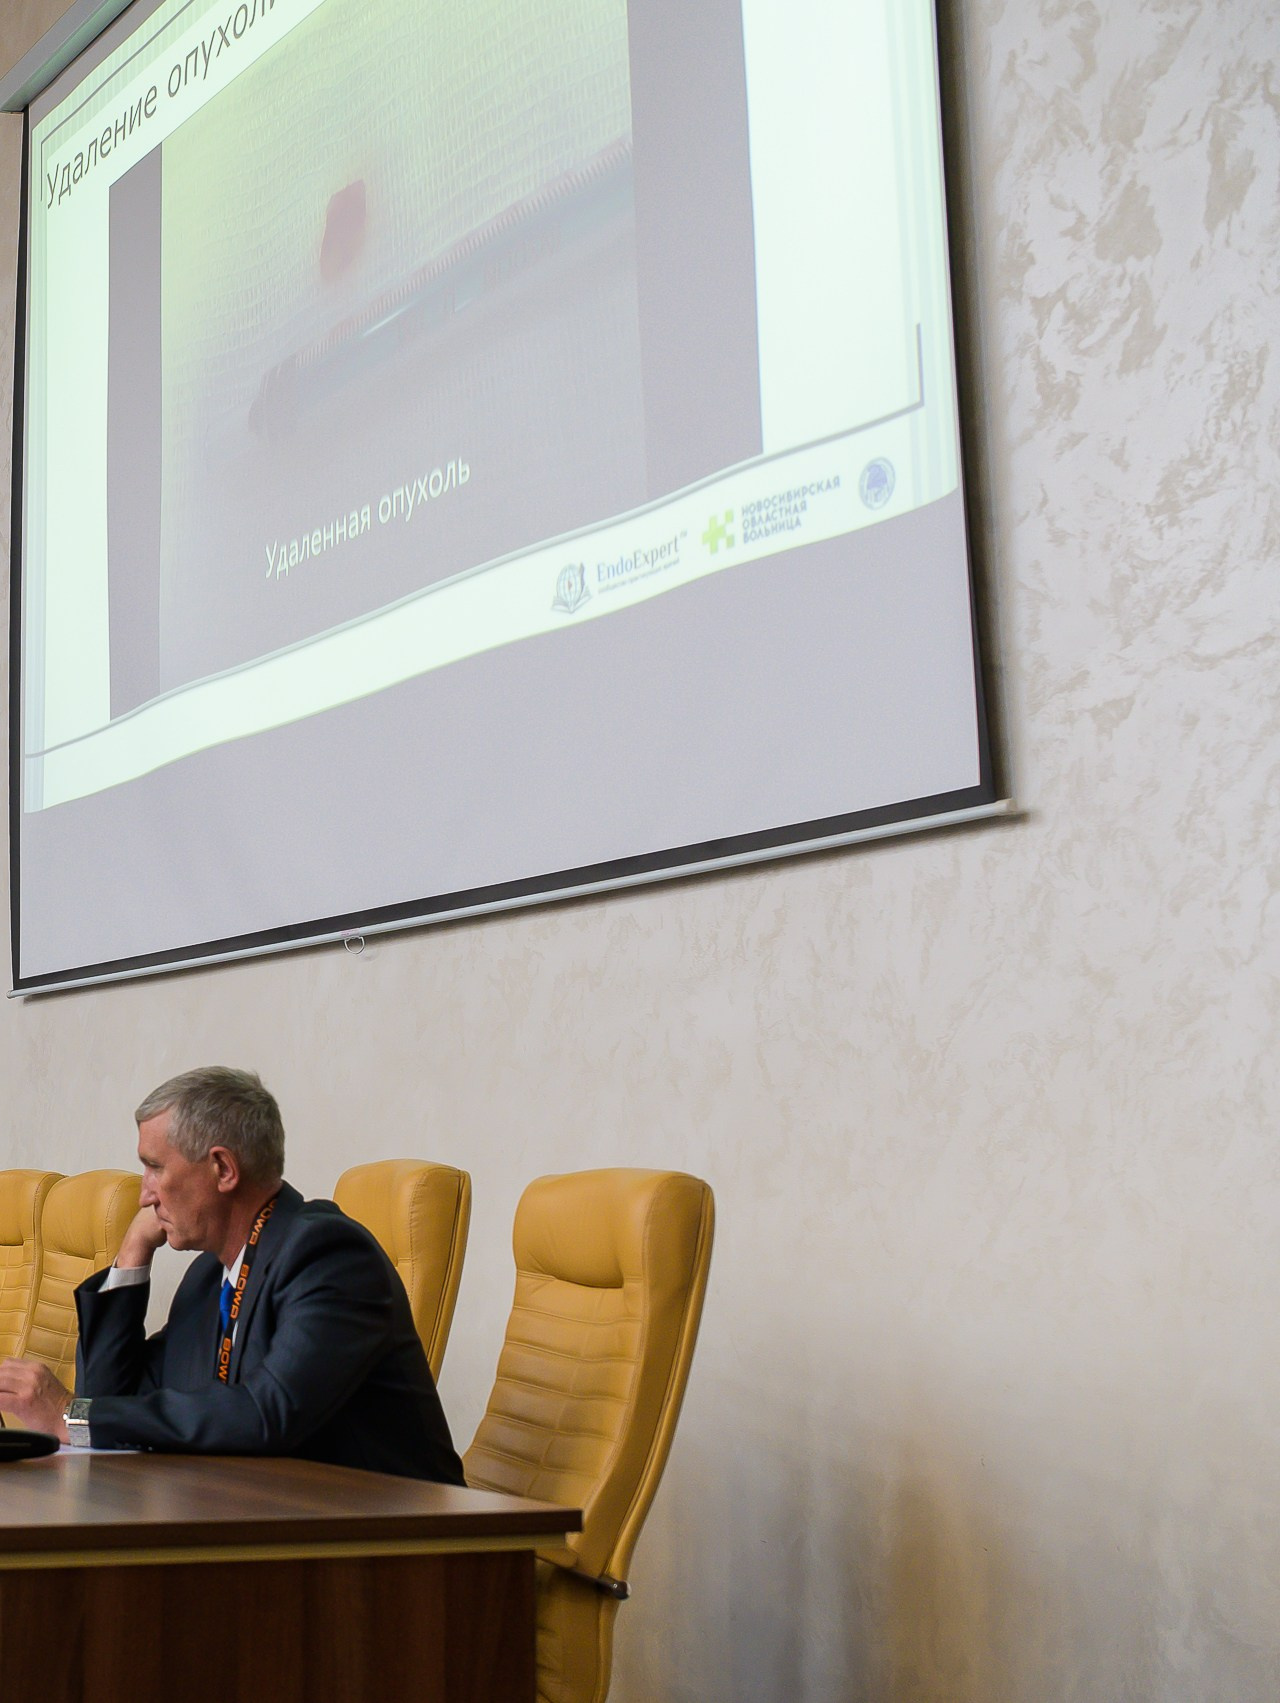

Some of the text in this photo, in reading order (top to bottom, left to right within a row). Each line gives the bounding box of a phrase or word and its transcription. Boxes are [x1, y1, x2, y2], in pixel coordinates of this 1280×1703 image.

[46, 0, 275, 209] Удаление опухол
[264, 456, 471, 580] Удаленная опухоль
[741, 475, 841, 516] НОВОСИБИРСКАЯ
[597, 535, 679, 582] EndoExpert
[218, 1337, 232, 1384] BOW
